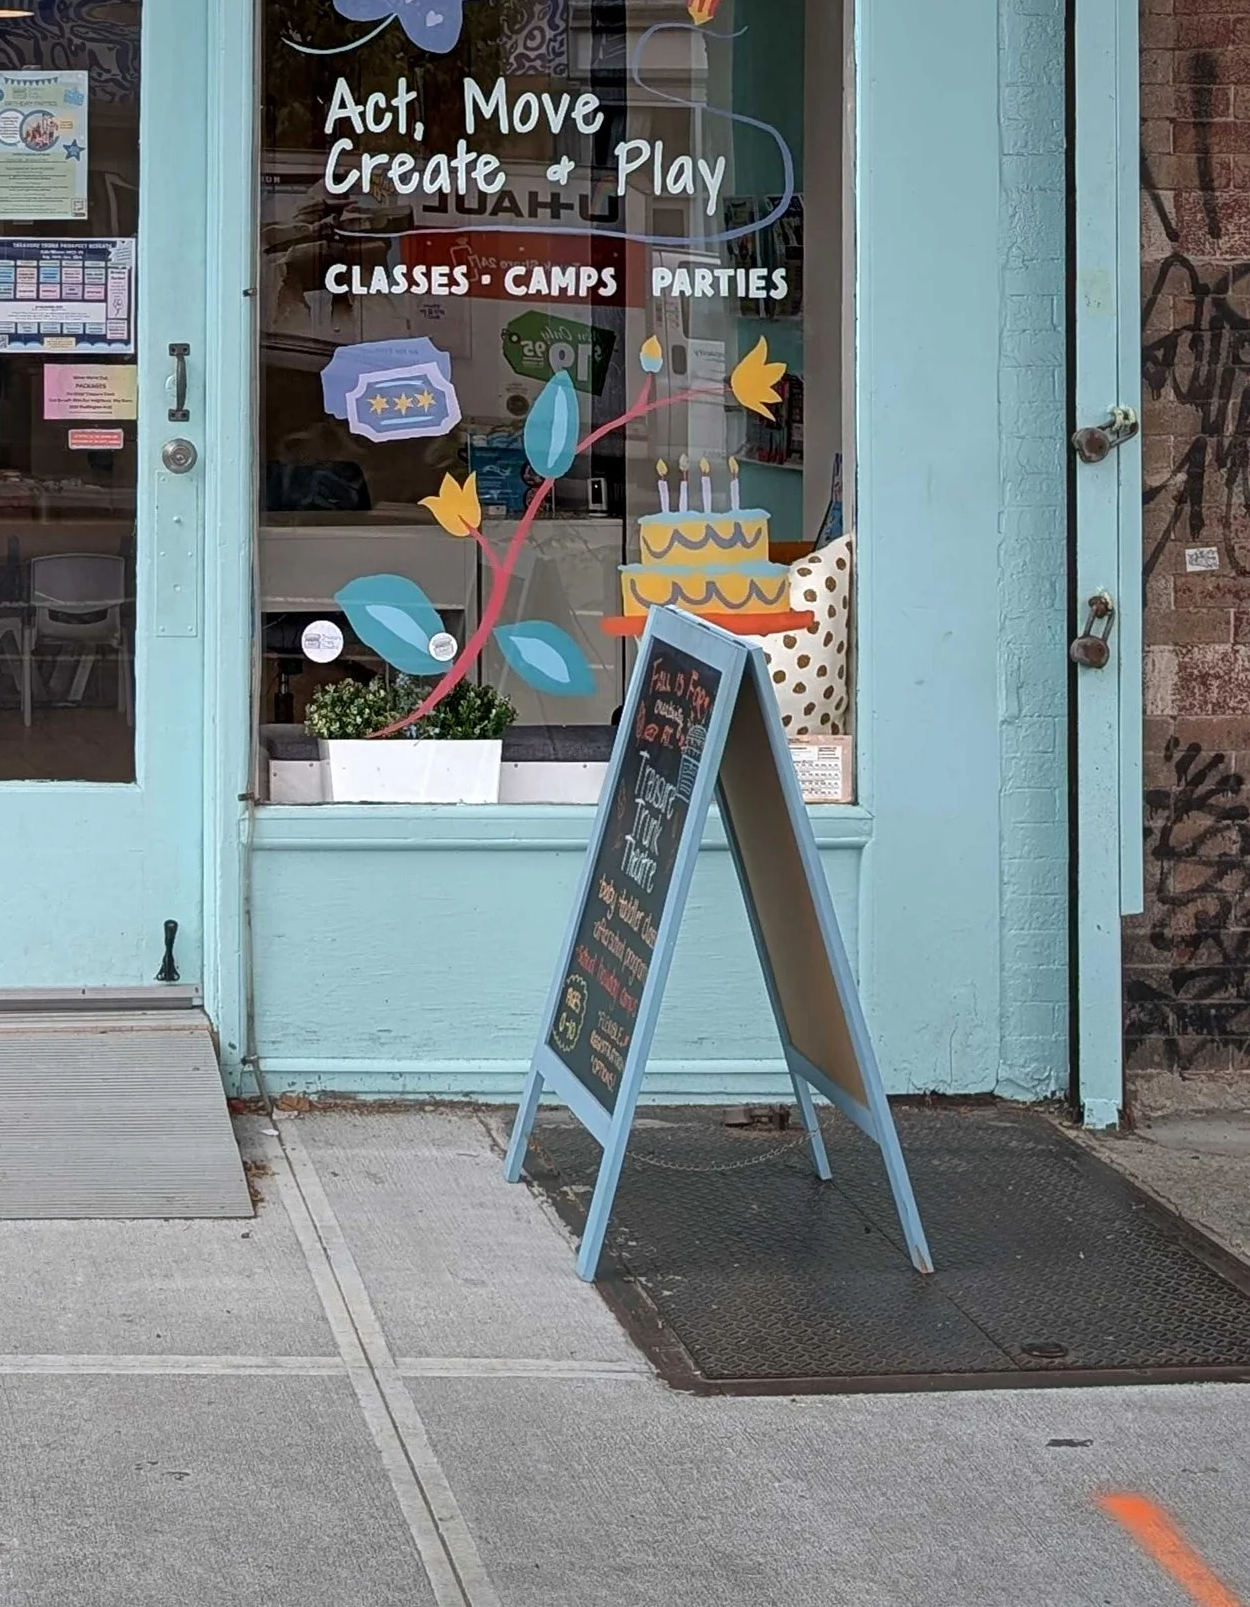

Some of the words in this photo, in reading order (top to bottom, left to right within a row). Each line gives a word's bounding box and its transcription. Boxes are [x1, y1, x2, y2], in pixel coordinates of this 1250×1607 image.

[325, 77, 423, 141] Act,
[464, 77, 603, 134] Move
[325, 139, 505, 194] Create
[615, 140, 725, 216] Play
[325, 264, 468, 295] CLASSES
[505, 266, 616, 296] CAMPS
[653, 267, 787, 299] PARTIES
[635, 749, 677, 820] Treasure
[631, 798, 663, 856] Trunk
[621, 834, 657, 893] Theatre
